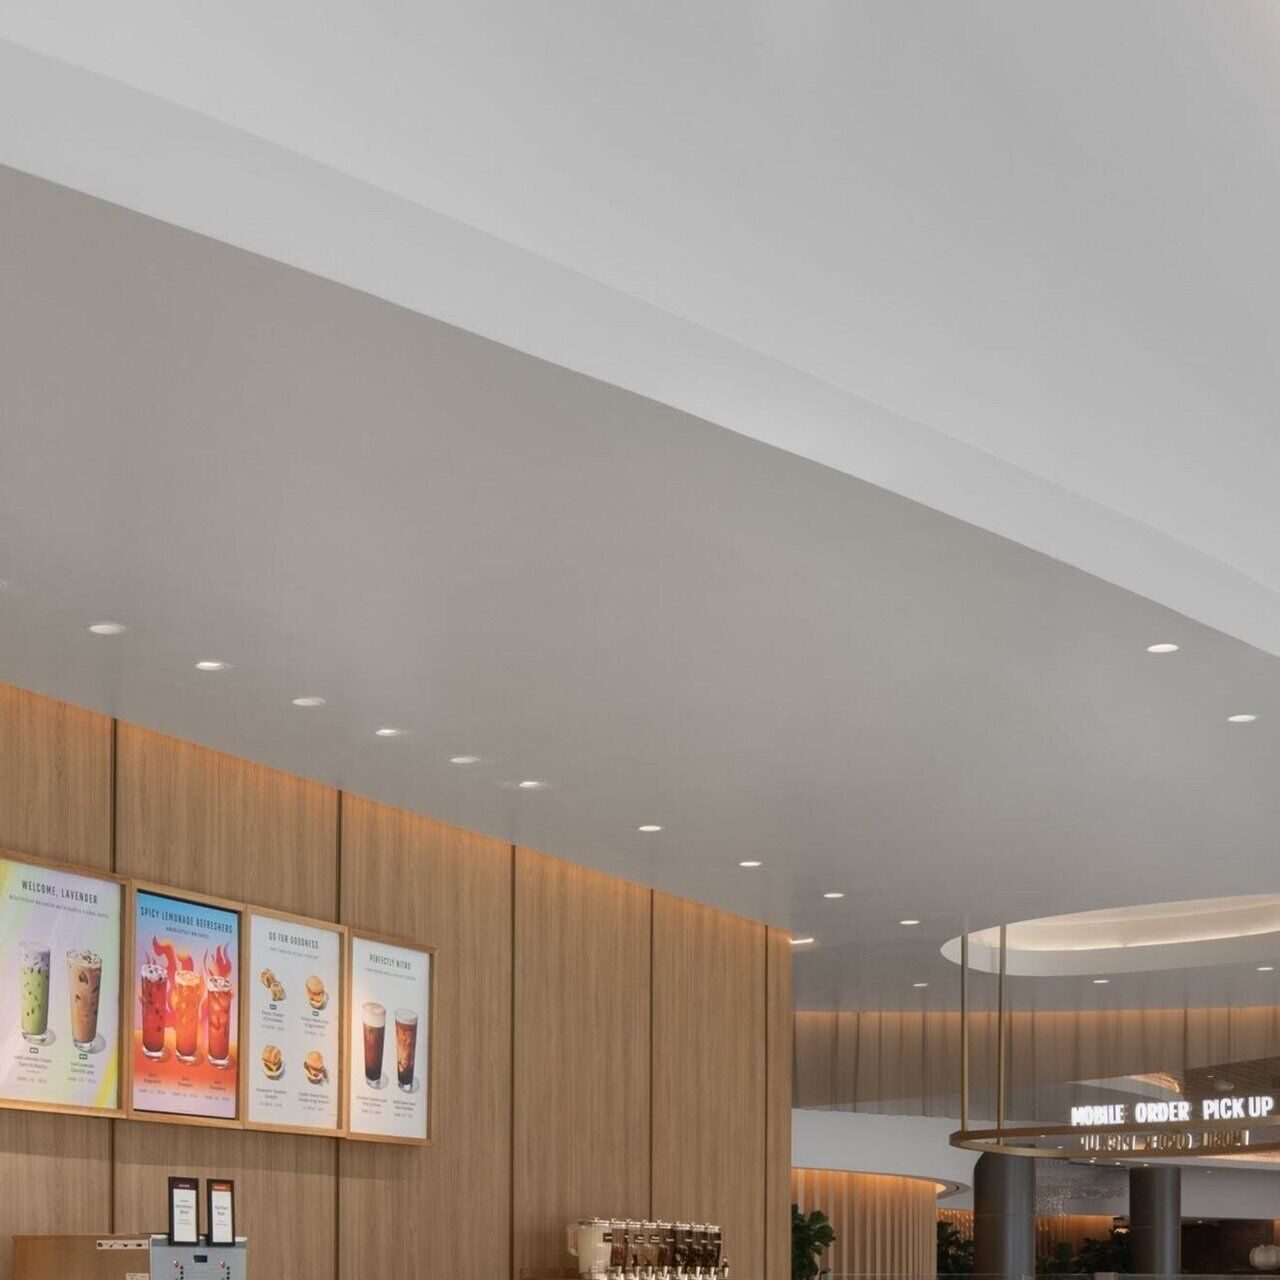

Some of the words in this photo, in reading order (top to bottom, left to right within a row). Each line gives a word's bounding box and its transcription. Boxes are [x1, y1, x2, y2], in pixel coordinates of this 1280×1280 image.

[61, 889, 98, 904] LAVENDER
[1071, 1104, 1124, 1126] MOBILE
[1135, 1101, 1190, 1122] ORDER
[1203, 1098, 1245, 1120] PICK
[1248, 1096, 1274, 1117] UP
